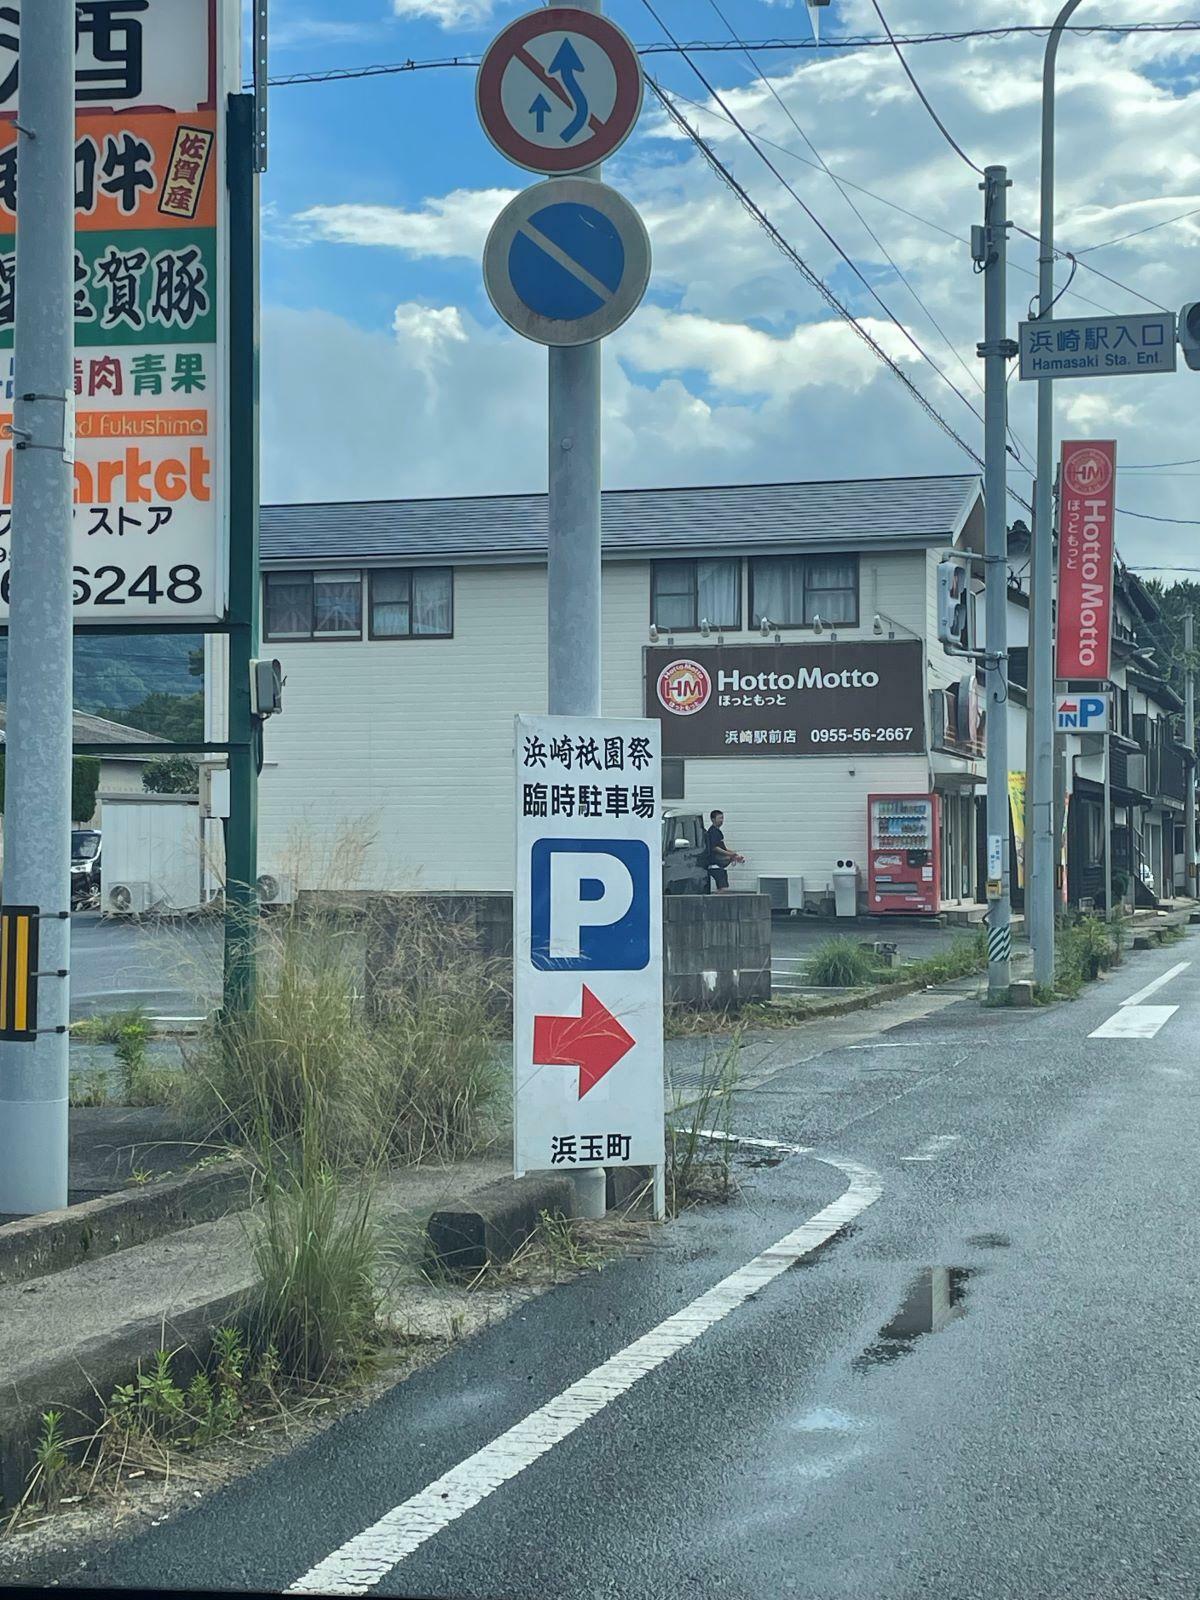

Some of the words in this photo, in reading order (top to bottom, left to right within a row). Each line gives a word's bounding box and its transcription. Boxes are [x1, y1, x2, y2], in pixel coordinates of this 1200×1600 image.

[164, 132, 207, 212] 佐賀産
[1029, 324, 1164, 353] 浜崎駅入口
[1032, 356, 1099, 371] Hamasaki
[1105, 353, 1131, 366] Sta.
[1066, 500, 1081, 570] ほっともっと
[665, 680, 703, 698] HM
[718, 694, 787, 707] ほっともっと
[1058, 713, 1078, 728] IN
[1080, 699, 1105, 728] P
[724, 730, 797, 745] 浜崎駅前店
[810, 727, 914, 743] 0955-56-2667
[523, 782, 656, 819] 臨時駐車場
[550, 851, 634, 958] P
[551, 1133, 632, 1164] 浜玉町
